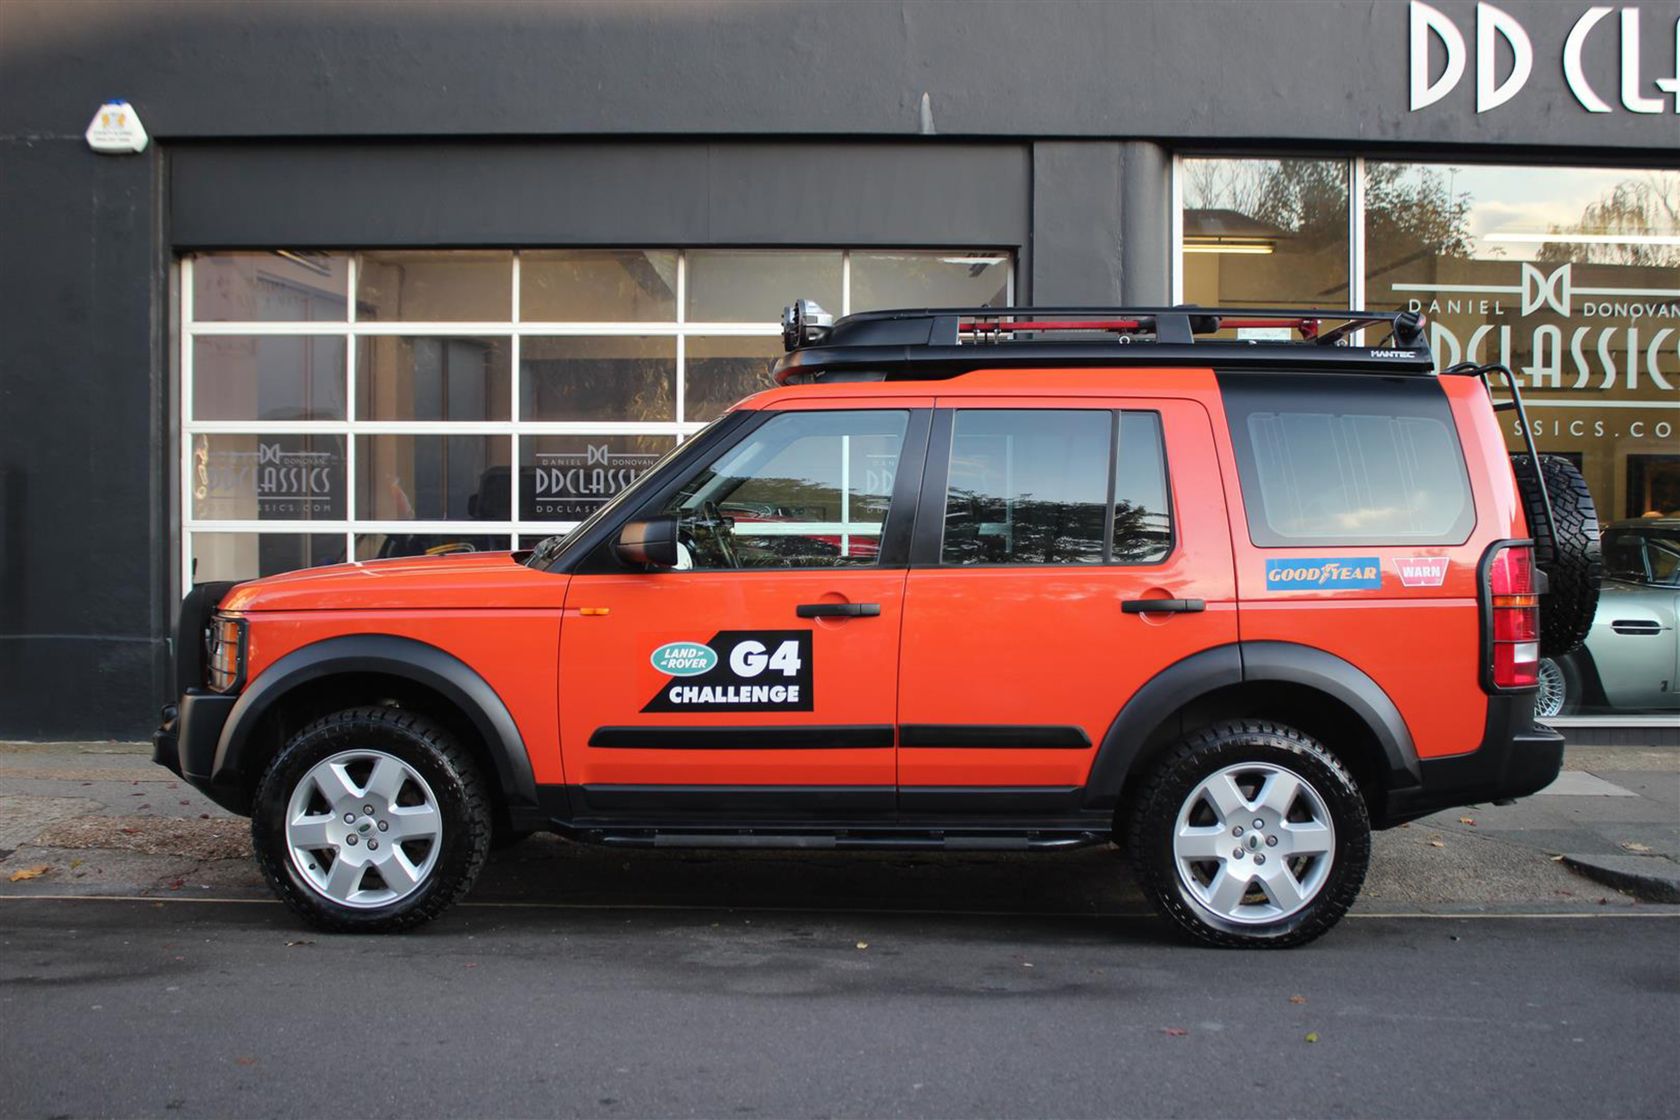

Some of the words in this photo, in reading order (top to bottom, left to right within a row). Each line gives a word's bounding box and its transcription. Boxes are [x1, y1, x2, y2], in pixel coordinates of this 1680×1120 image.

[1410, 0, 1533, 113] DD
[1563, 7, 1680, 113] CL
[1408, 299, 1504, 315] DANIEL
[1584, 302, 1680, 318] DONOVAN
[1370, 350, 1417, 359] MANTEC
[1392, 321, 1680, 390] DCLASSIC
[1514, 420, 1672, 438] SSICS.CO
[1268, 563, 1377, 583] GOODYEAR
[1402, 566, 1441, 578] WARN
[729, 640, 801, 678] G4
[669, 685, 799, 704] CHALLENGE
